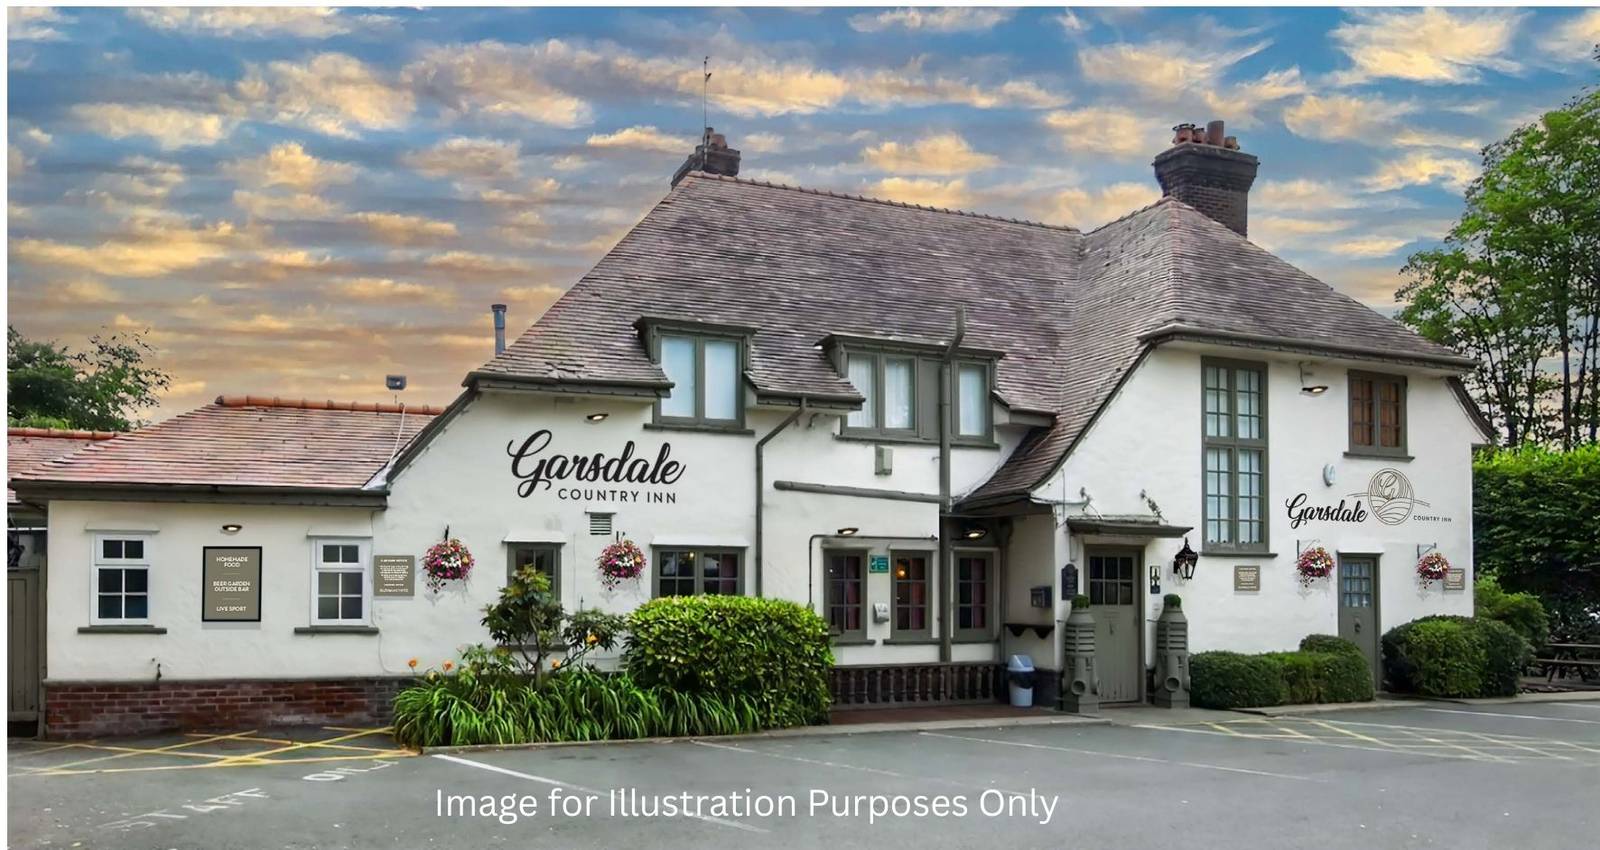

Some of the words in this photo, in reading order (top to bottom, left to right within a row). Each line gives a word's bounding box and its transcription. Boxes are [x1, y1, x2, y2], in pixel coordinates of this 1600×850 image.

[507, 429, 687, 498] Garsdale
[558, 488, 640, 502] COUNTRY
[647, 492, 676, 503] INN
[1285, 493, 1368, 529] Garsdale
[1413, 514, 1440, 522] COUNTRY
